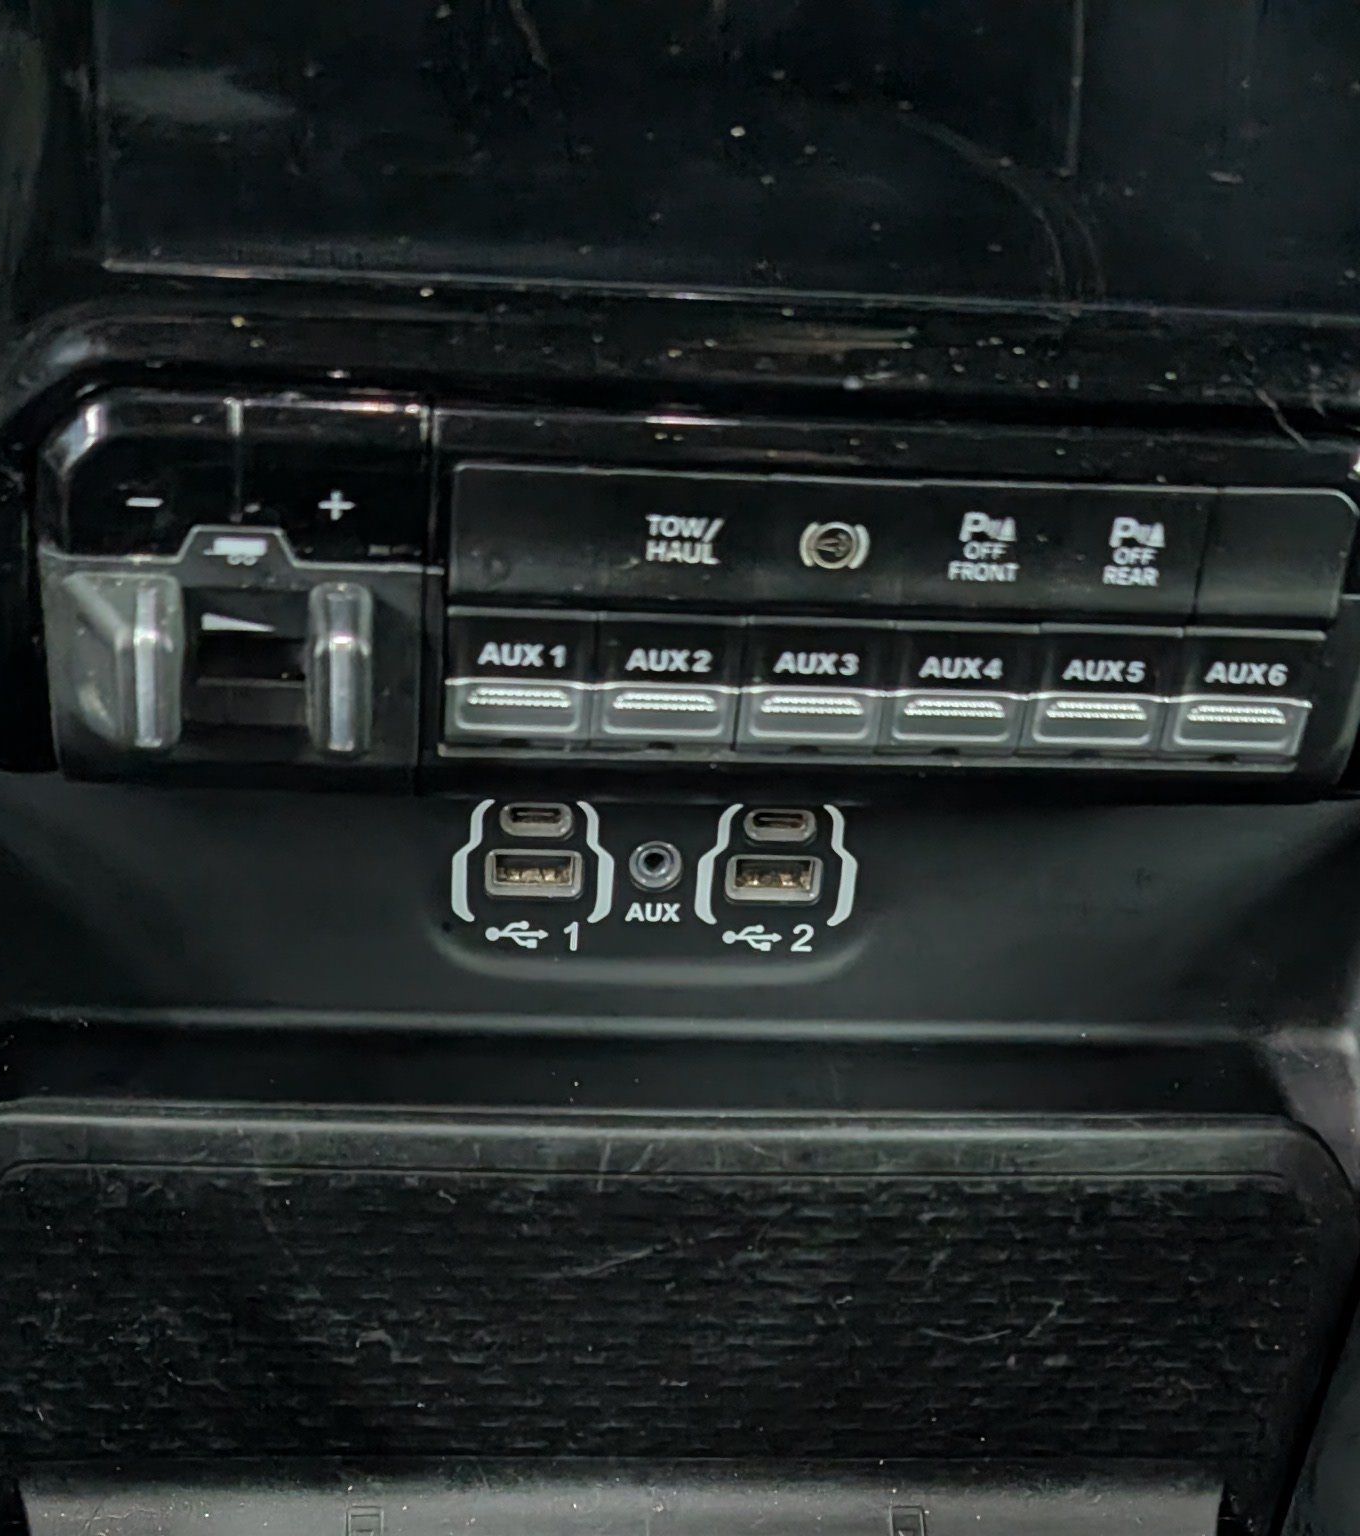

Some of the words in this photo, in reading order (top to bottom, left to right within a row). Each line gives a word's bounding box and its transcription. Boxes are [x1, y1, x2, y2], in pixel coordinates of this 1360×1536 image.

[645, 514, 725, 544] TOW/
[645, 539, 721, 565] HAUL
[963, 541, 1007, 560] OFF
[1112, 547, 1159, 566] OFF
[947, 562, 1021, 583] FRONT
[1102, 565, 1160, 587] REAR
[625, 902, 681, 923] AUX
[563, 922, 581, 952] 1
[790, 924, 814, 953] 2
